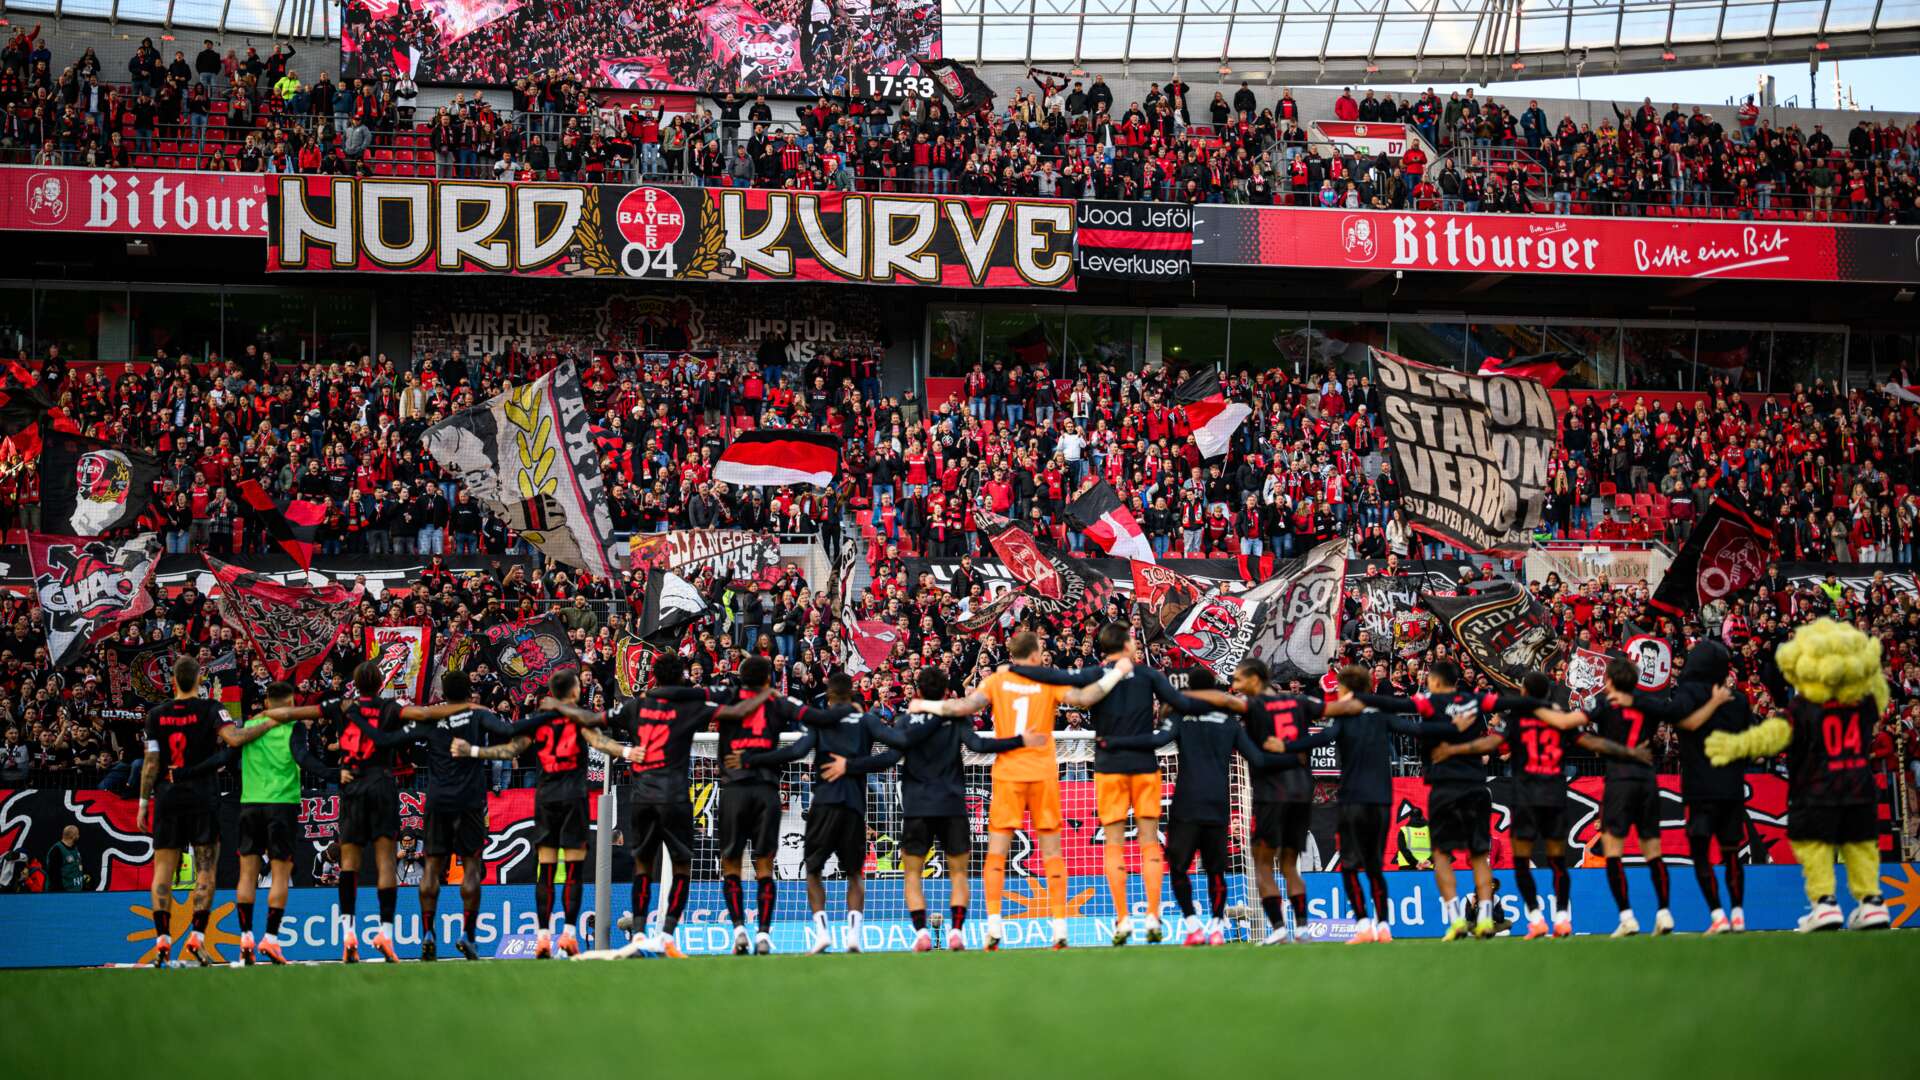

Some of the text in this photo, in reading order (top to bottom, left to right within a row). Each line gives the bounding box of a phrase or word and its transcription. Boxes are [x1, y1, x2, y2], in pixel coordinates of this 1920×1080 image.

[867, 75, 934, 97] 17:33
[84, 174, 268, 232] Bitbur
[619, 211, 681, 226] BAYER
[644, 190, 657, 249] BAYER
[1078, 205, 1132, 226] Jood
[721, 190, 1074, 287] KURVE
[1391, 215, 1600, 270] Bitburger
[1633, 227, 1790, 272] Bitte ein Bit
[620, 242, 678, 278] 04
[1079, 251, 1191, 275] Leverkusen
[451, 308, 550, 336] WIR FÜR
[749, 316, 836, 342] IHR FÜR
[468, 334, 532, 357] EUCH
[1385, 395, 1553, 487] STADON
[1403, 495, 1424, 511] SV
[1426, 501, 1461, 532] BAYER
[40, 567, 137, 615] CHAO
[1011, 696, 1030, 736] 1
[1274, 709, 1299, 743] 5
[1622, 708, 1645, 748] 7
[1822, 713, 1862, 757] 04
[1520, 728, 1562, 772] 13
[279, 901, 600, 947] schaunslan
